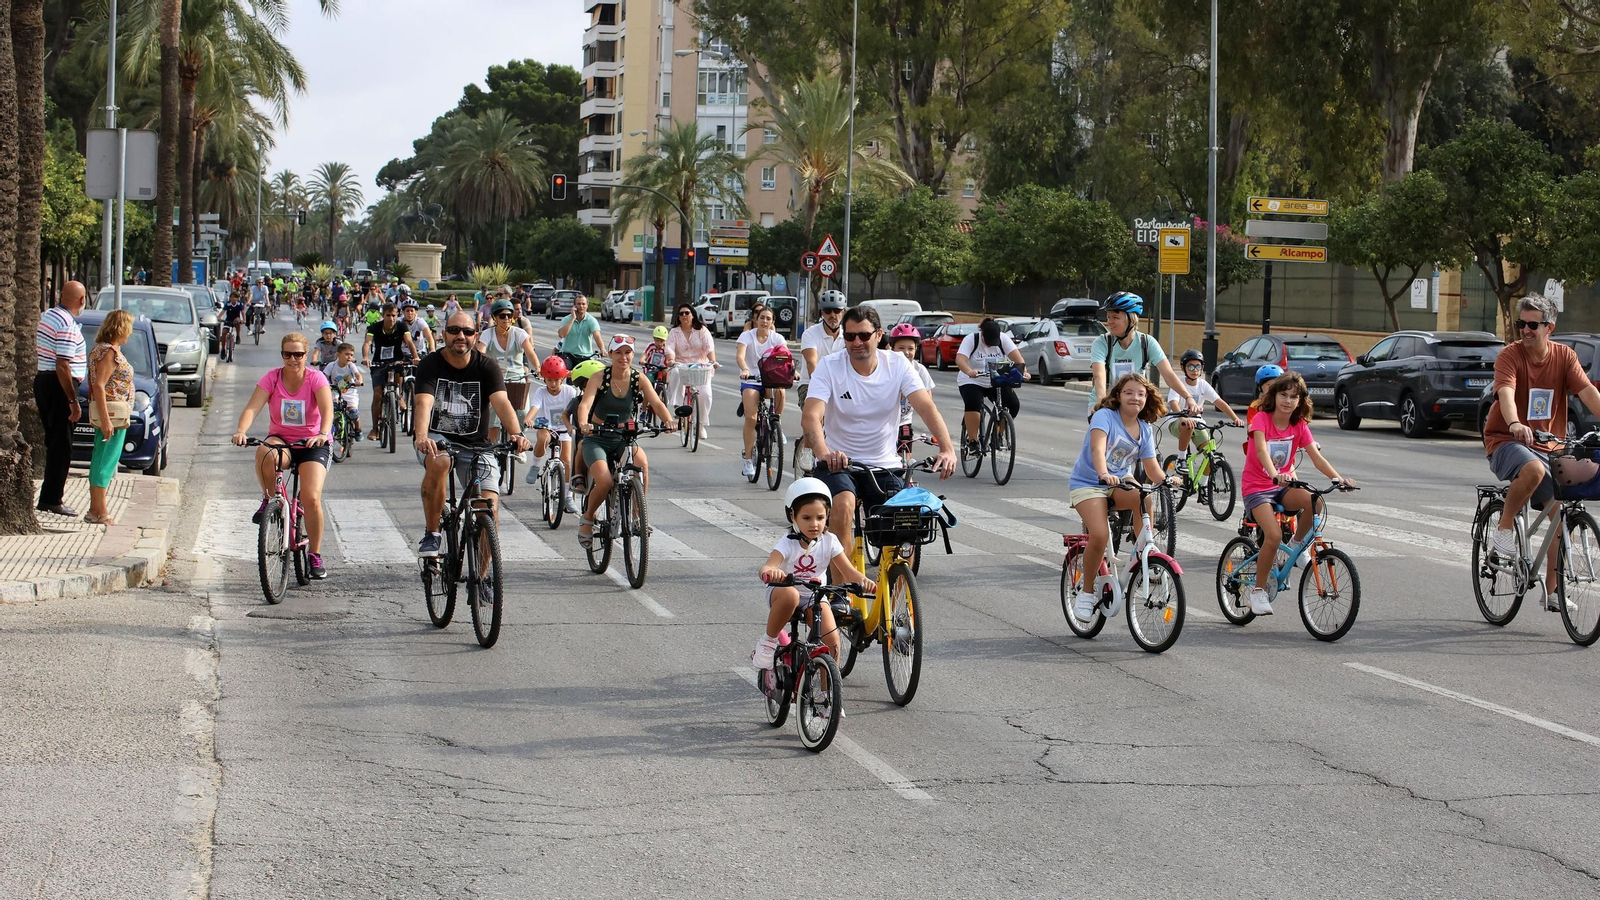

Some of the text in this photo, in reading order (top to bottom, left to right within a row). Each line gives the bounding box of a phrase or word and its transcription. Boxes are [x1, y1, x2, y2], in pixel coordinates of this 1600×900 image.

[1133, 217, 1191, 229] Restaurante
[1137, 230, 1160, 243] El B
[1280, 248, 1324, 259] Alcampo
